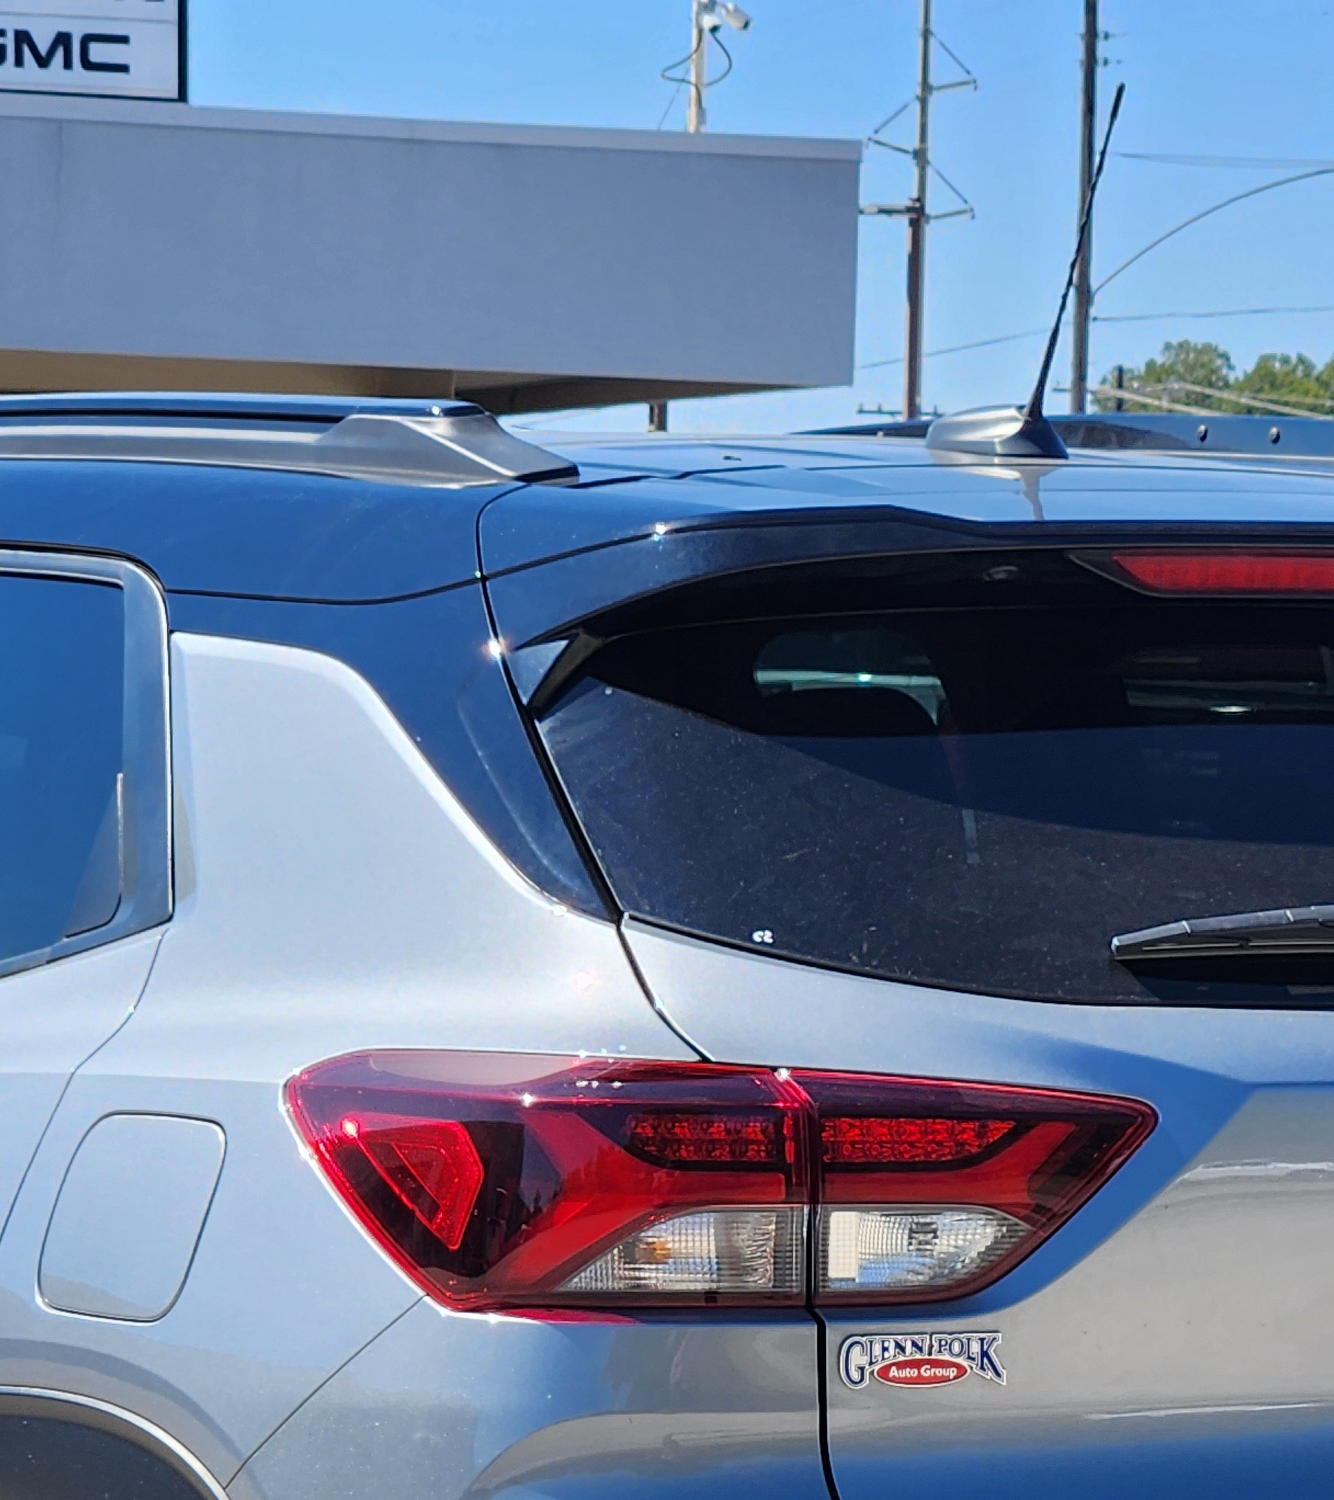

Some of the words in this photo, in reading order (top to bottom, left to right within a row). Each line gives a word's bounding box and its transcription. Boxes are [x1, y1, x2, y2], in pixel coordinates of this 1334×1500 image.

[843, 1335, 927, 1386] GLENN
[934, 1334, 1005, 1384] POLK
[888, 1365, 918, 1379] Auto
[920, 1364, 958, 1379] Group
